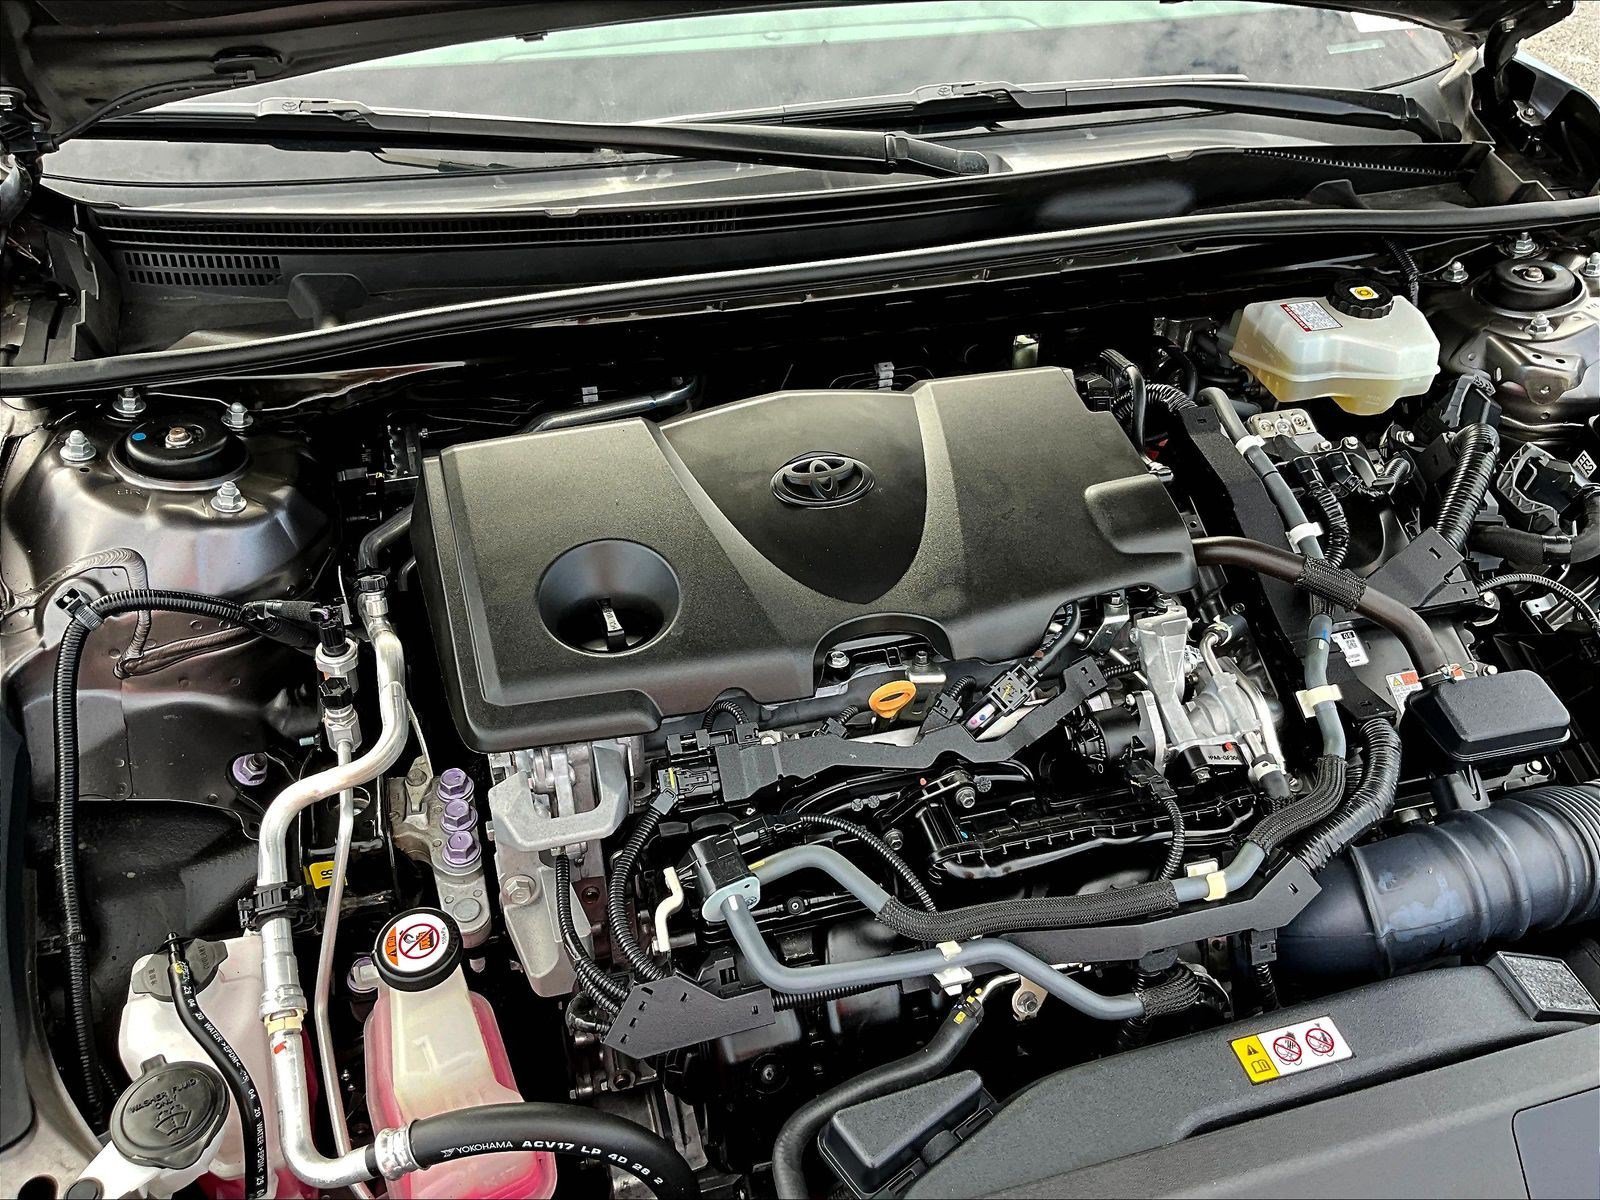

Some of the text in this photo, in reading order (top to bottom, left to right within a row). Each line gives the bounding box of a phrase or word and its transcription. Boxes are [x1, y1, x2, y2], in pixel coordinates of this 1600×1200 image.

[1578, 453, 1593, 475] EE2
[195, 1011, 205, 1020] 20
[204, 1021, 223, 1043] WATER
[221, 1041, 241, 1067] >EPDM<
[130, 1078, 198, 1113] WASHER FLUID
[155, 1095, 177, 1109] ONLY
[247, 1088, 256, 1099] 04
[254, 1107, 262, 1118] 20
[256, 1121, 265, 1147] WATER
[456, 1140, 513, 1154] YOKOHAMA
[521, 1140, 575, 1150] ACV17
[580, 1145, 602, 1155] LP
[608, 1153, 628, 1164] 4D
[653, 1177, 664, 1185] 2
